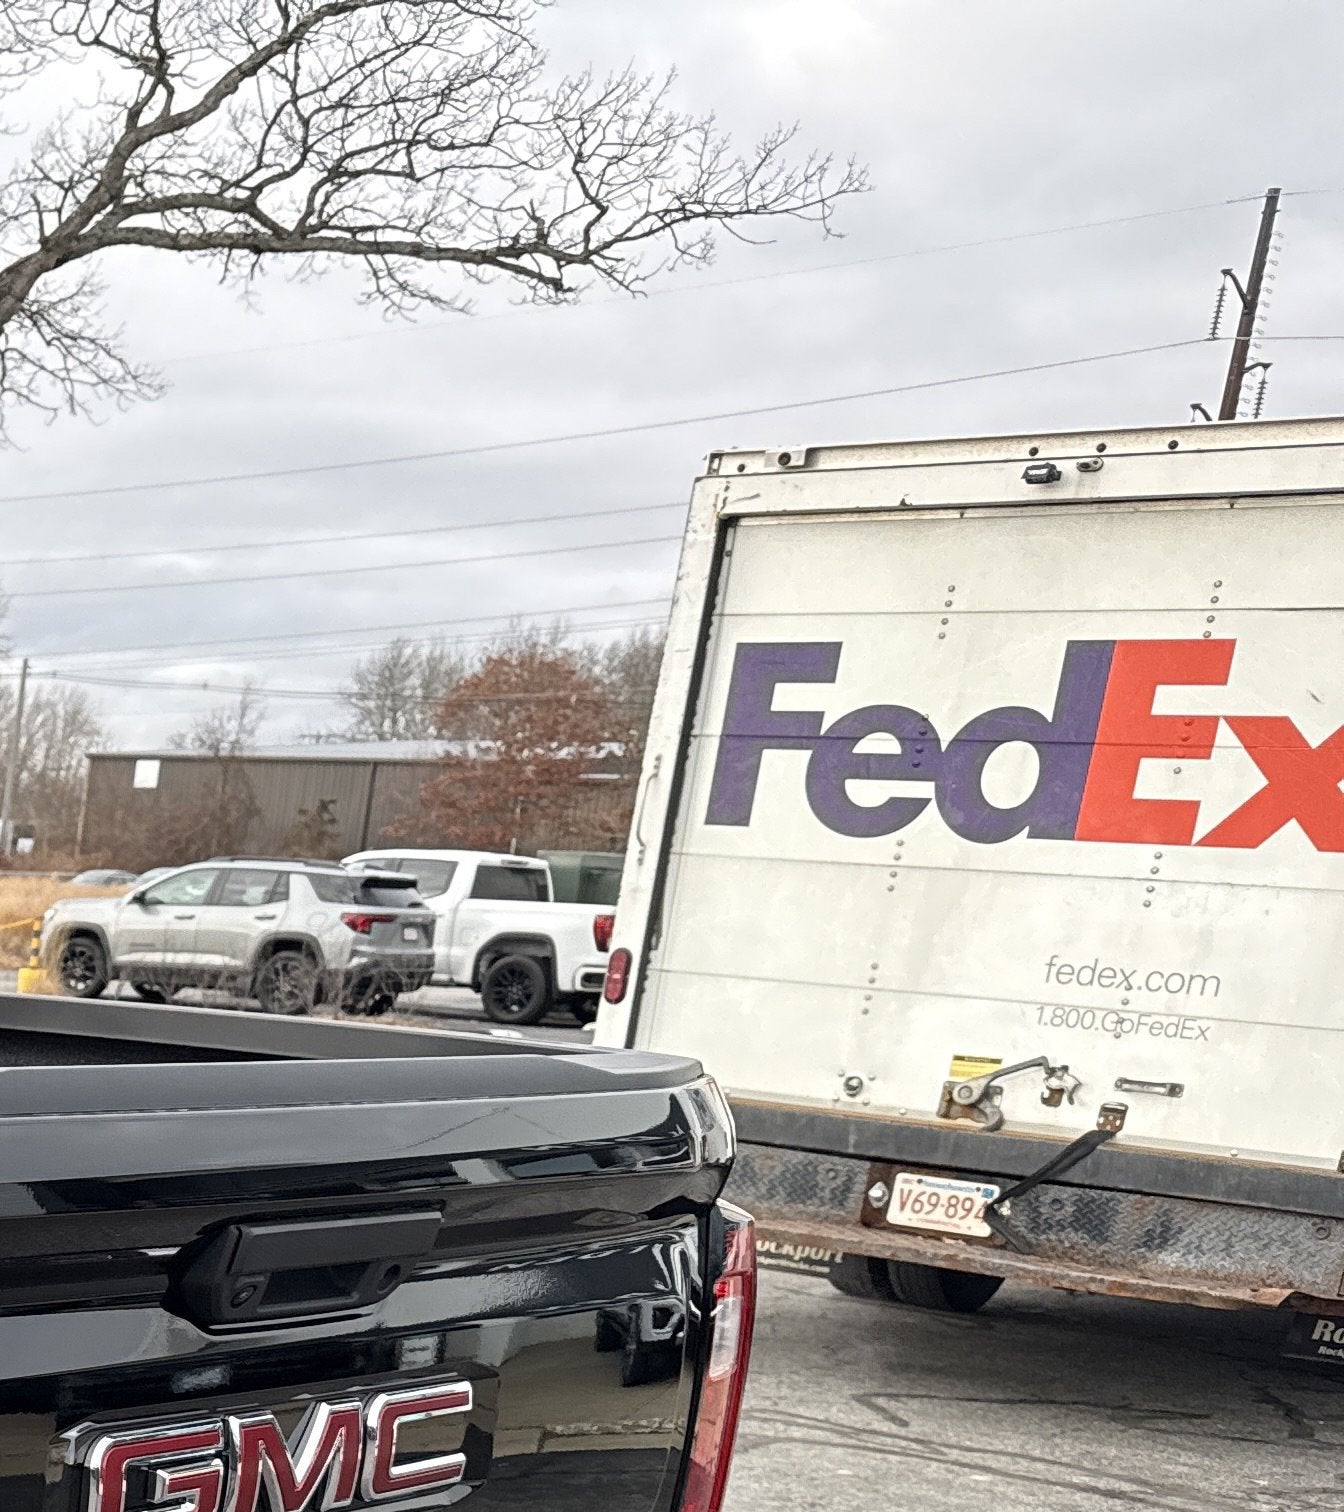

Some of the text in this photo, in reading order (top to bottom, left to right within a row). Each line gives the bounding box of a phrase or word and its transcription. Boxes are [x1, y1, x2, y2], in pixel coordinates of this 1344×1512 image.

[704, 638, 1344, 853] FedEx
[1045, 955, 1221, 997] fedex.com
[1036, 1006, 1211, 1041] 1.800.GoFedEx
